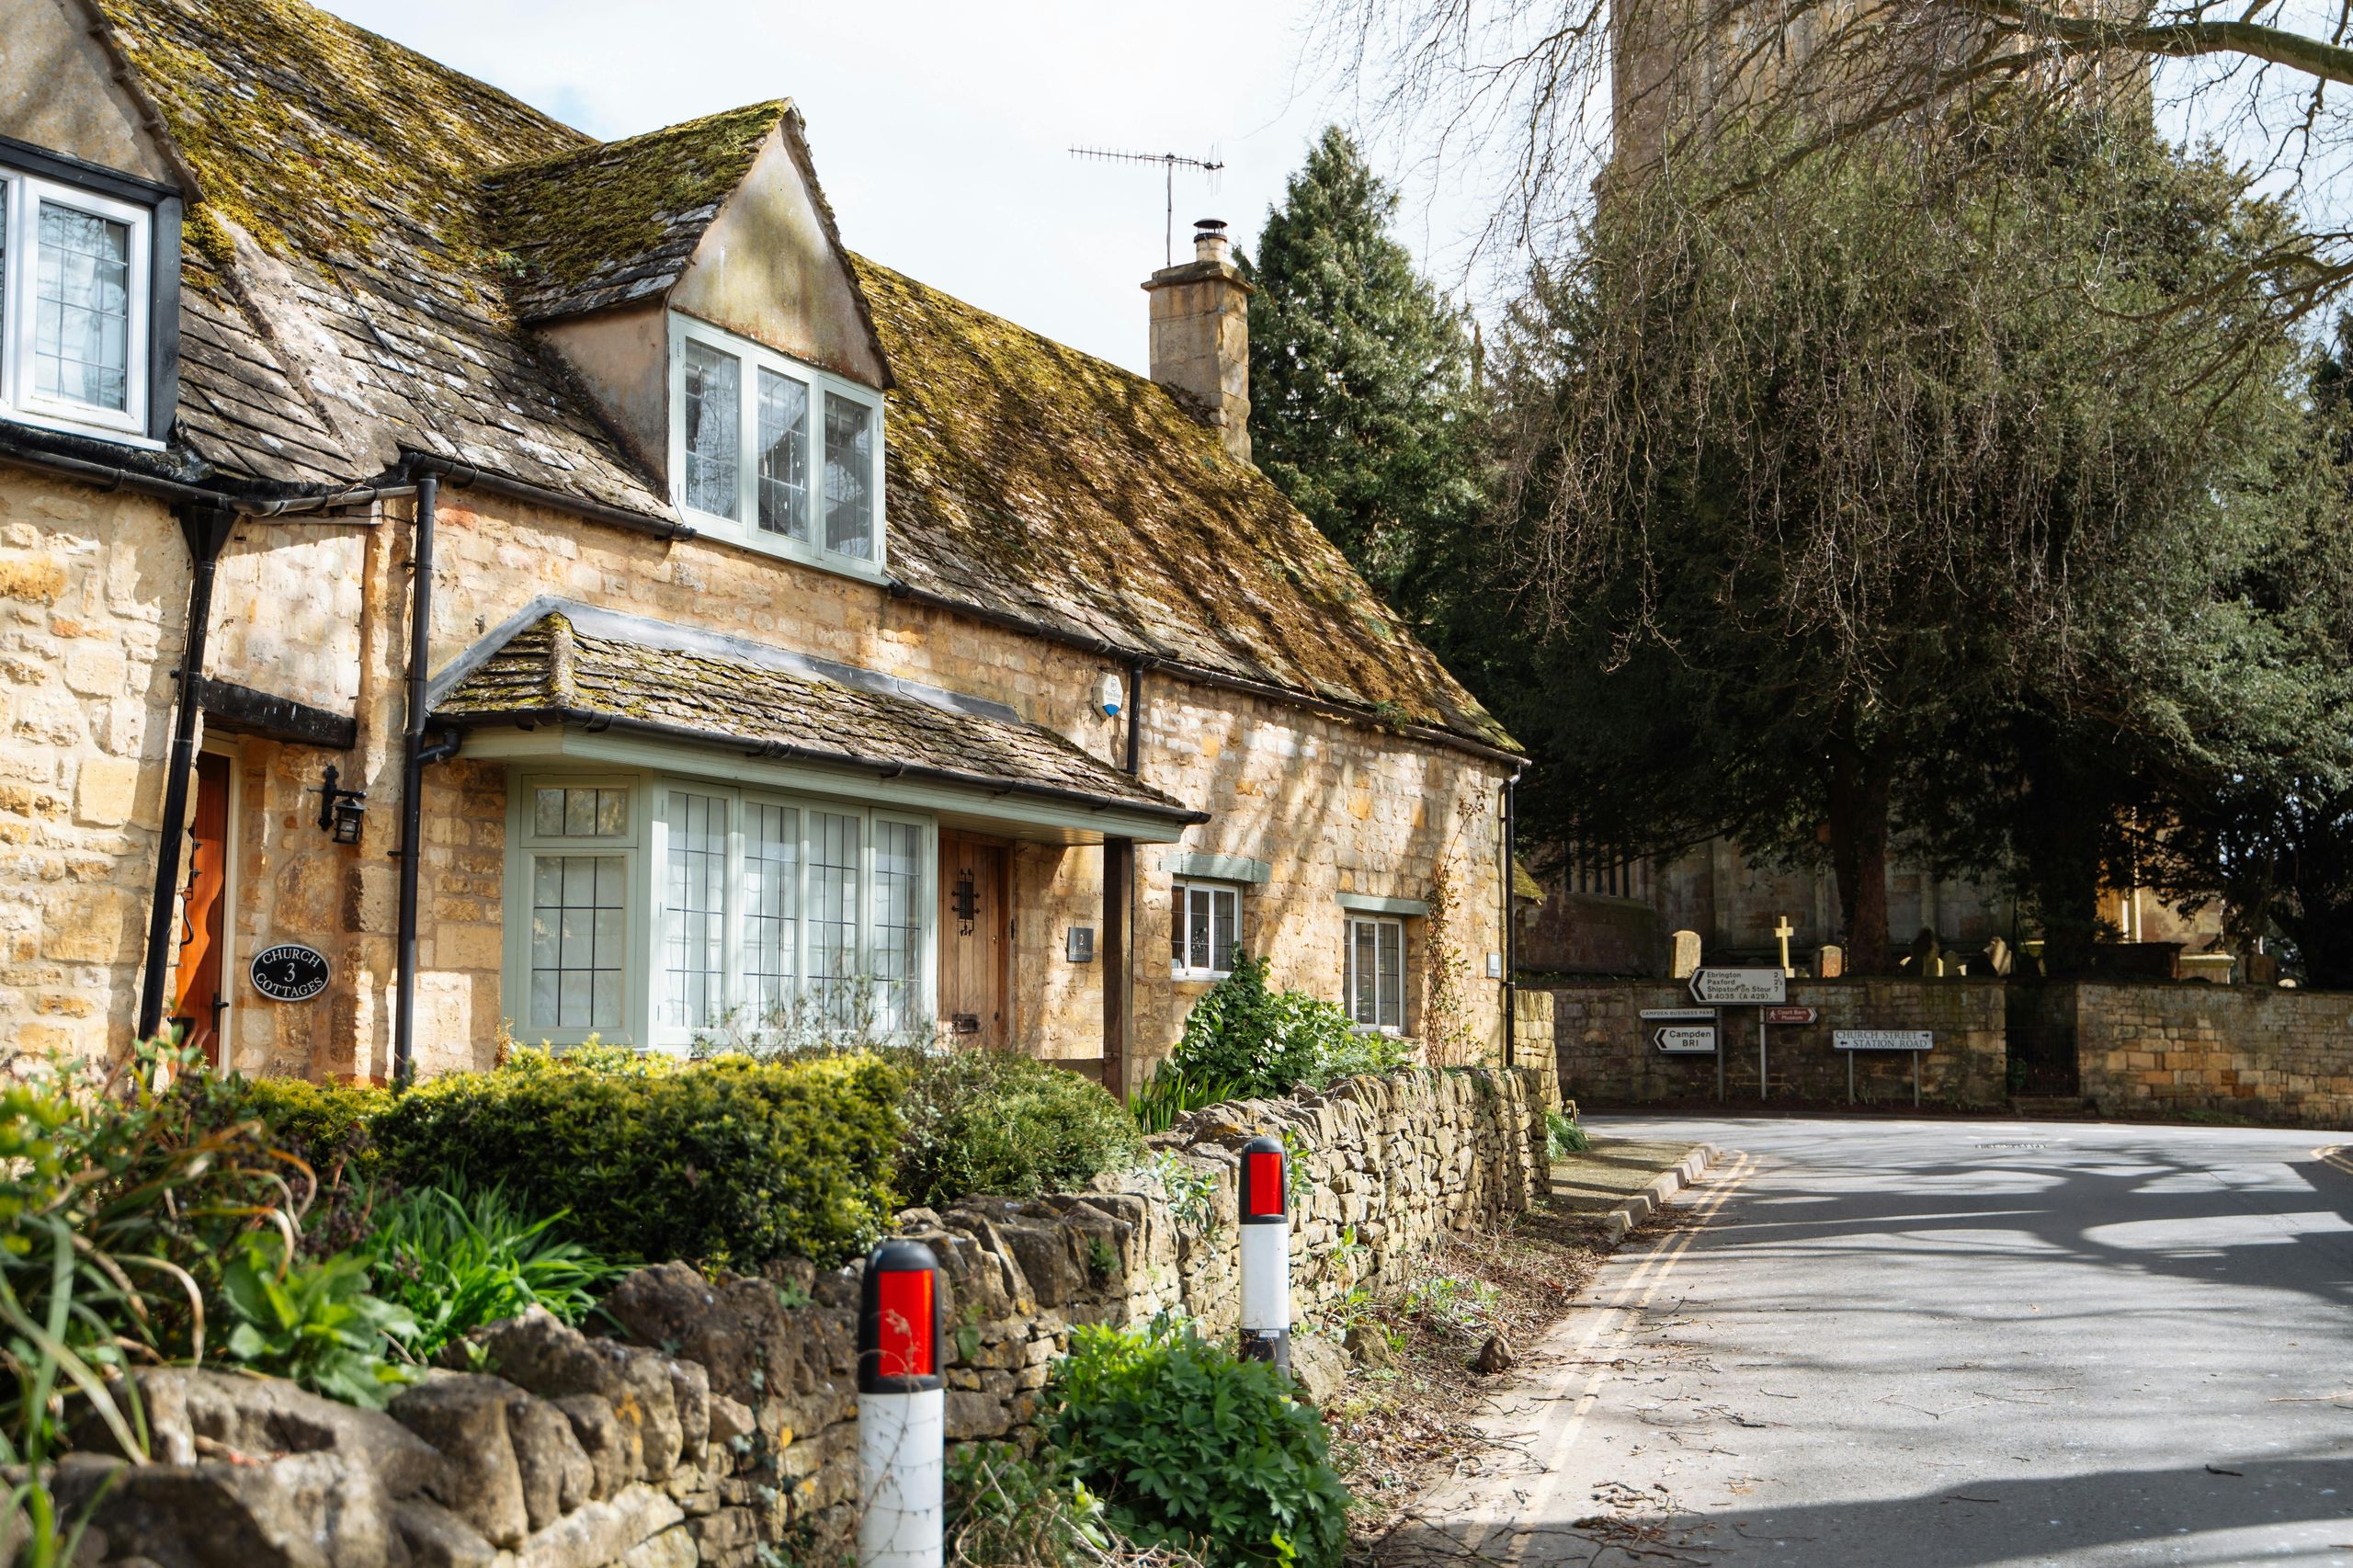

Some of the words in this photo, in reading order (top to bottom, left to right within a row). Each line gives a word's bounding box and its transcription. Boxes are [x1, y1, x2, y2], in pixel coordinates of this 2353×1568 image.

[1080, 934, 1084, 945] 2
[262, 949, 321, 968] CHURCH
[284, 962, 296, 983] 3
[256, 972, 324, 997] COTTAGES
[1669, 1030, 1711, 1040] Campden
[1836, 1031, 1878, 1040] CHURCH
[1883, 1030, 1916, 1039] STREET
[1853, 1040, 1895, 1048] STATION
[1899, 1040, 1927, 1048] ROAD
